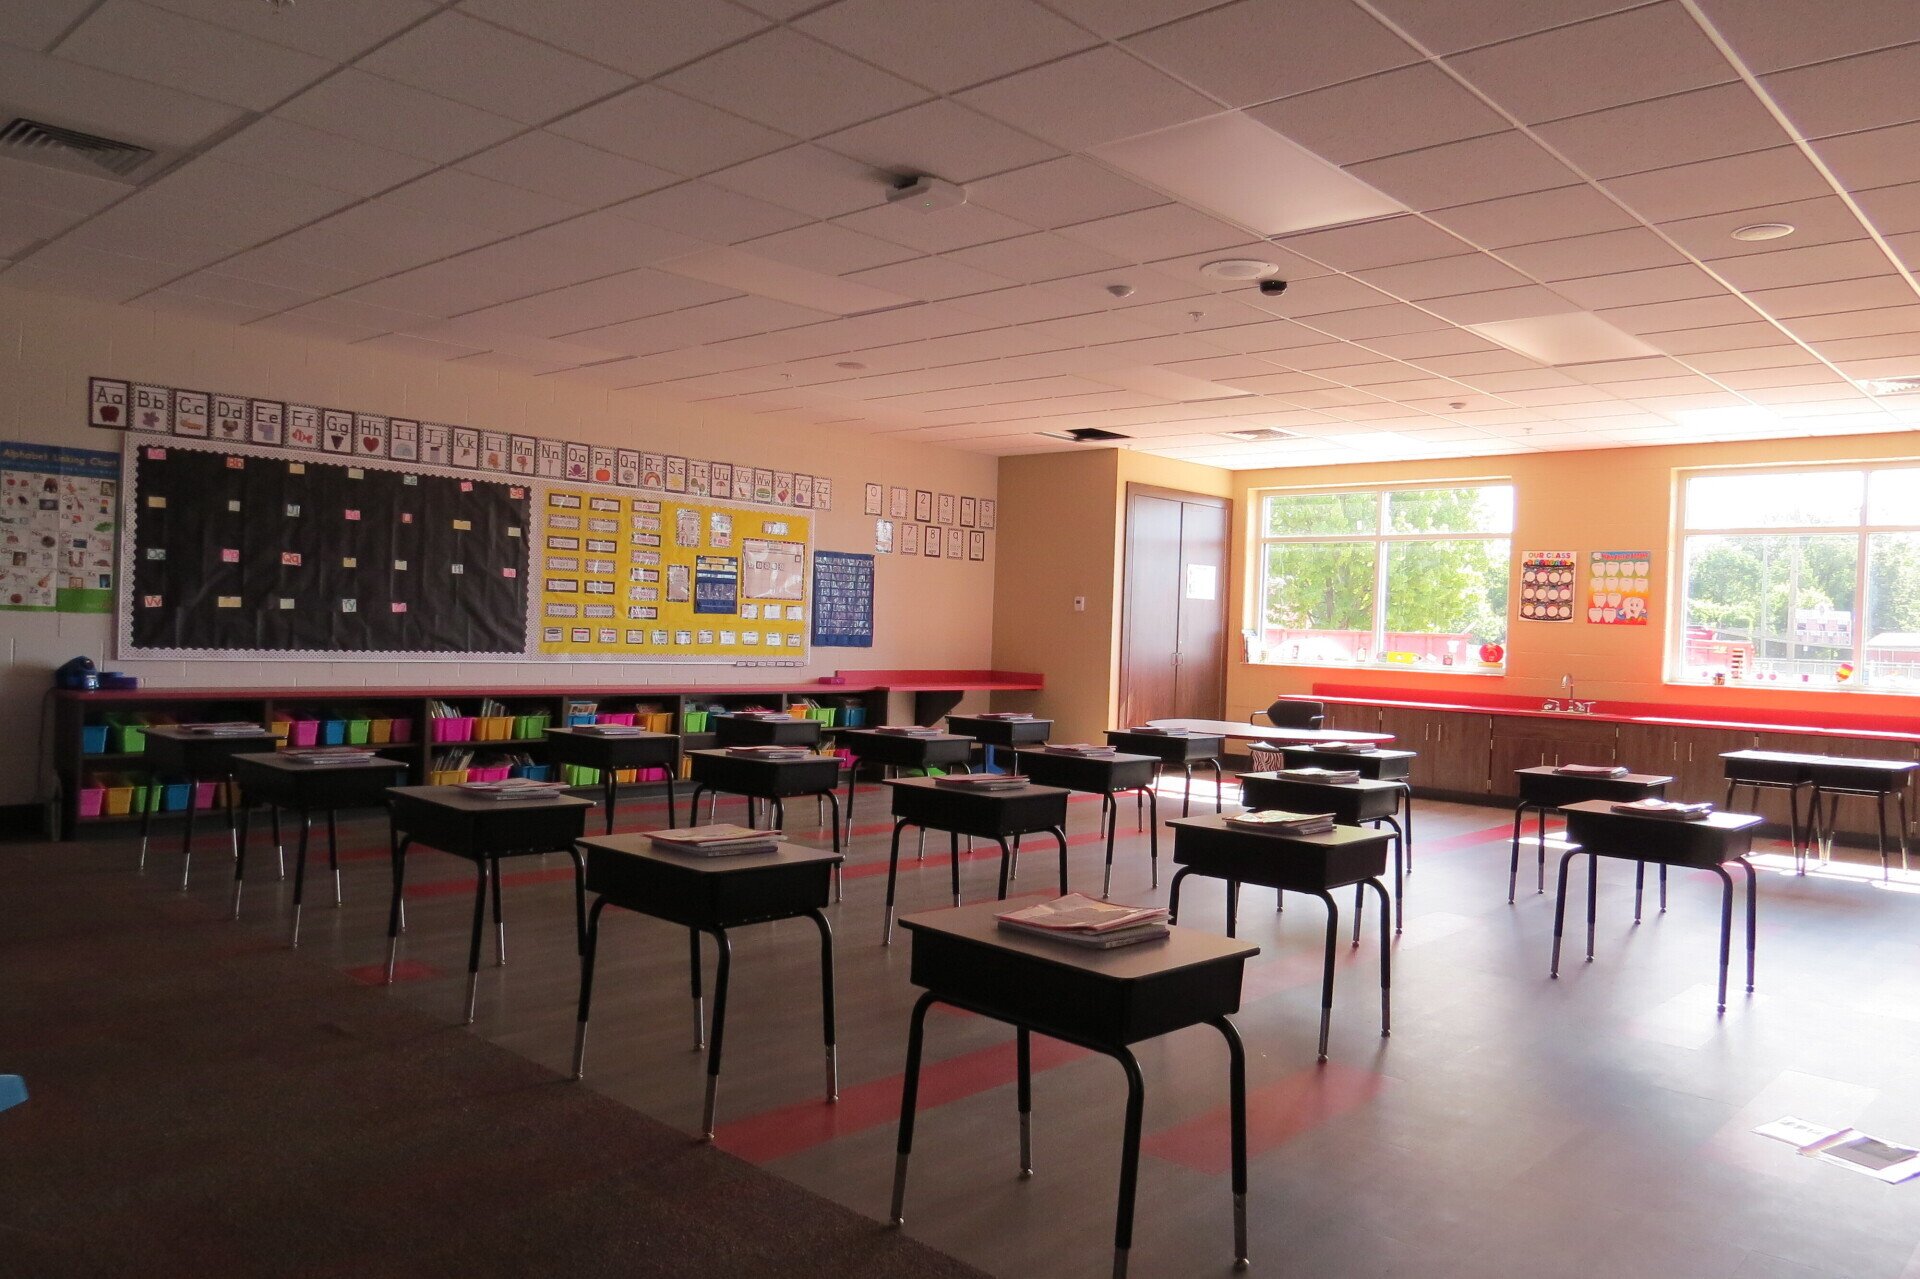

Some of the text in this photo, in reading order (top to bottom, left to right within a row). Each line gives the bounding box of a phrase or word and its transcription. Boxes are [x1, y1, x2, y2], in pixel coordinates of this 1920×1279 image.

[96, 386, 123, 404] Aa
[138, 390, 164, 409] Bb
[179, 397, 204, 415] Cc
[218, 401, 242, 419] Dd
[256, 406, 278, 424] Ee
[292, 410, 313, 427] Ff
[326, 415, 349, 436] Gg
[361, 420, 382, 436] Hh
[425, 429, 443, 447] Jj
[456, 432, 474, 449] Kk
[486, 436, 502, 452] Ll
[514, 441, 532, 456] Mm
[542, 444, 559, 459] Nn
[569, 448, 586, 462] Oo
[595, 451, 611, 468] Pp
[620, 455, 636, 471] Qq
[645, 457, 660, 472] Rr
[668, 461, 683, 475] Ss
[691, 464, 705, 478] Tt
[713, 467, 729, 481] Uu
[736, 470, 749, 483] Vv
[756, 473, 770, 486] Ww
[776, 476, 790, 489] Xx
[797, 478, 810, 493] Yy
[816, 481, 828, 495] Zz
[920, 493, 926, 505] 2
[943, 496, 949, 508] 3
[965, 500, 971, 510] 4
[985, 502, 990, 512] 5
[908, 526, 913, 537] 7
[930, 529, 936, 540] 8
[953, 531, 959, 542] 9
